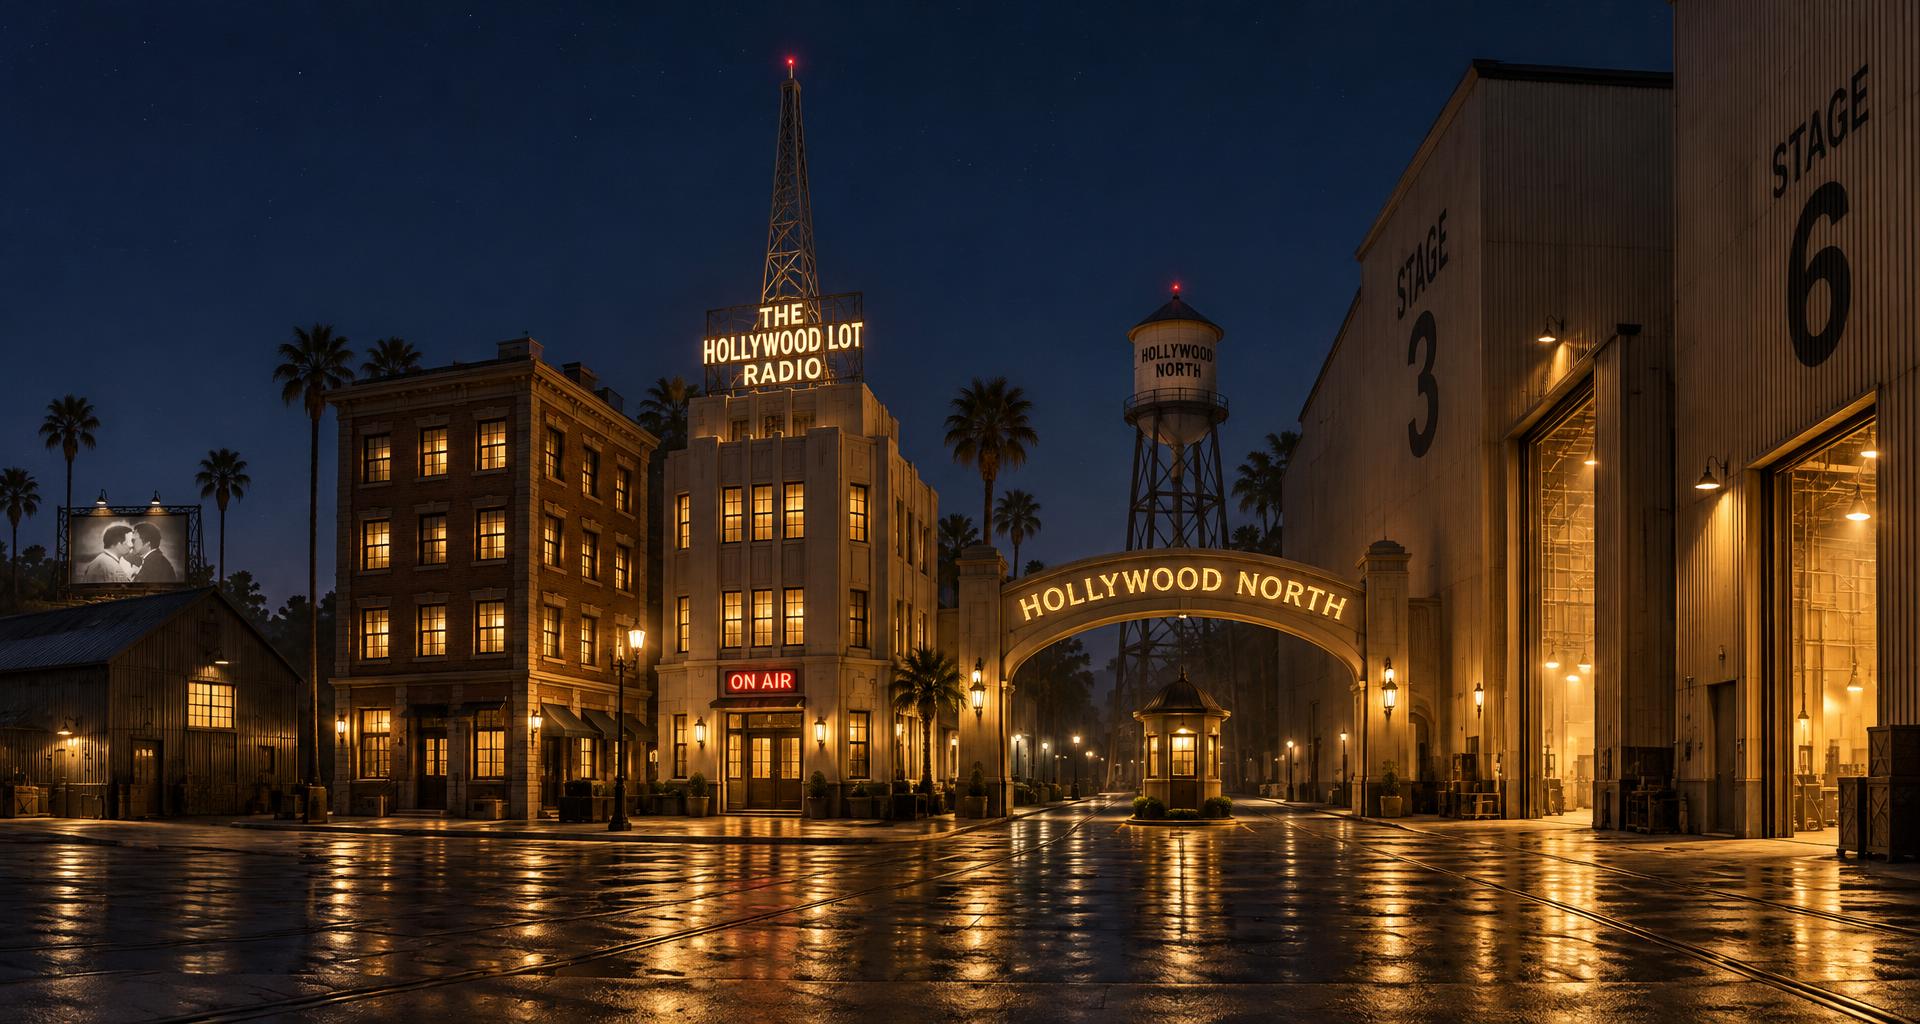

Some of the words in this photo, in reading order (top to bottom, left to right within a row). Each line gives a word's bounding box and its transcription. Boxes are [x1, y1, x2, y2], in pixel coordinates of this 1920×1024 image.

[1772, 63, 1869, 199] STAGE
[1397, 208, 1448, 321] STAGE
[1786, 180, 1851, 368] 6
[759, 303, 804, 329] THE
[703, 327, 822, 364] HOLLYWOOD
[828, 321, 863, 350] LOT
[1141, 343, 1213, 363] HOLLYWOOD
[743, 357, 822, 386] RADIO
[1156, 362, 1201, 378] NORTH
[1407, 310, 1439, 458] 3
[1019, 566, 1222, 621] HOLLYWOOD
[1236, 570, 1348, 621] NORTH
[731, 673, 756, 690] ON
[761, 672, 792, 689] AIR
